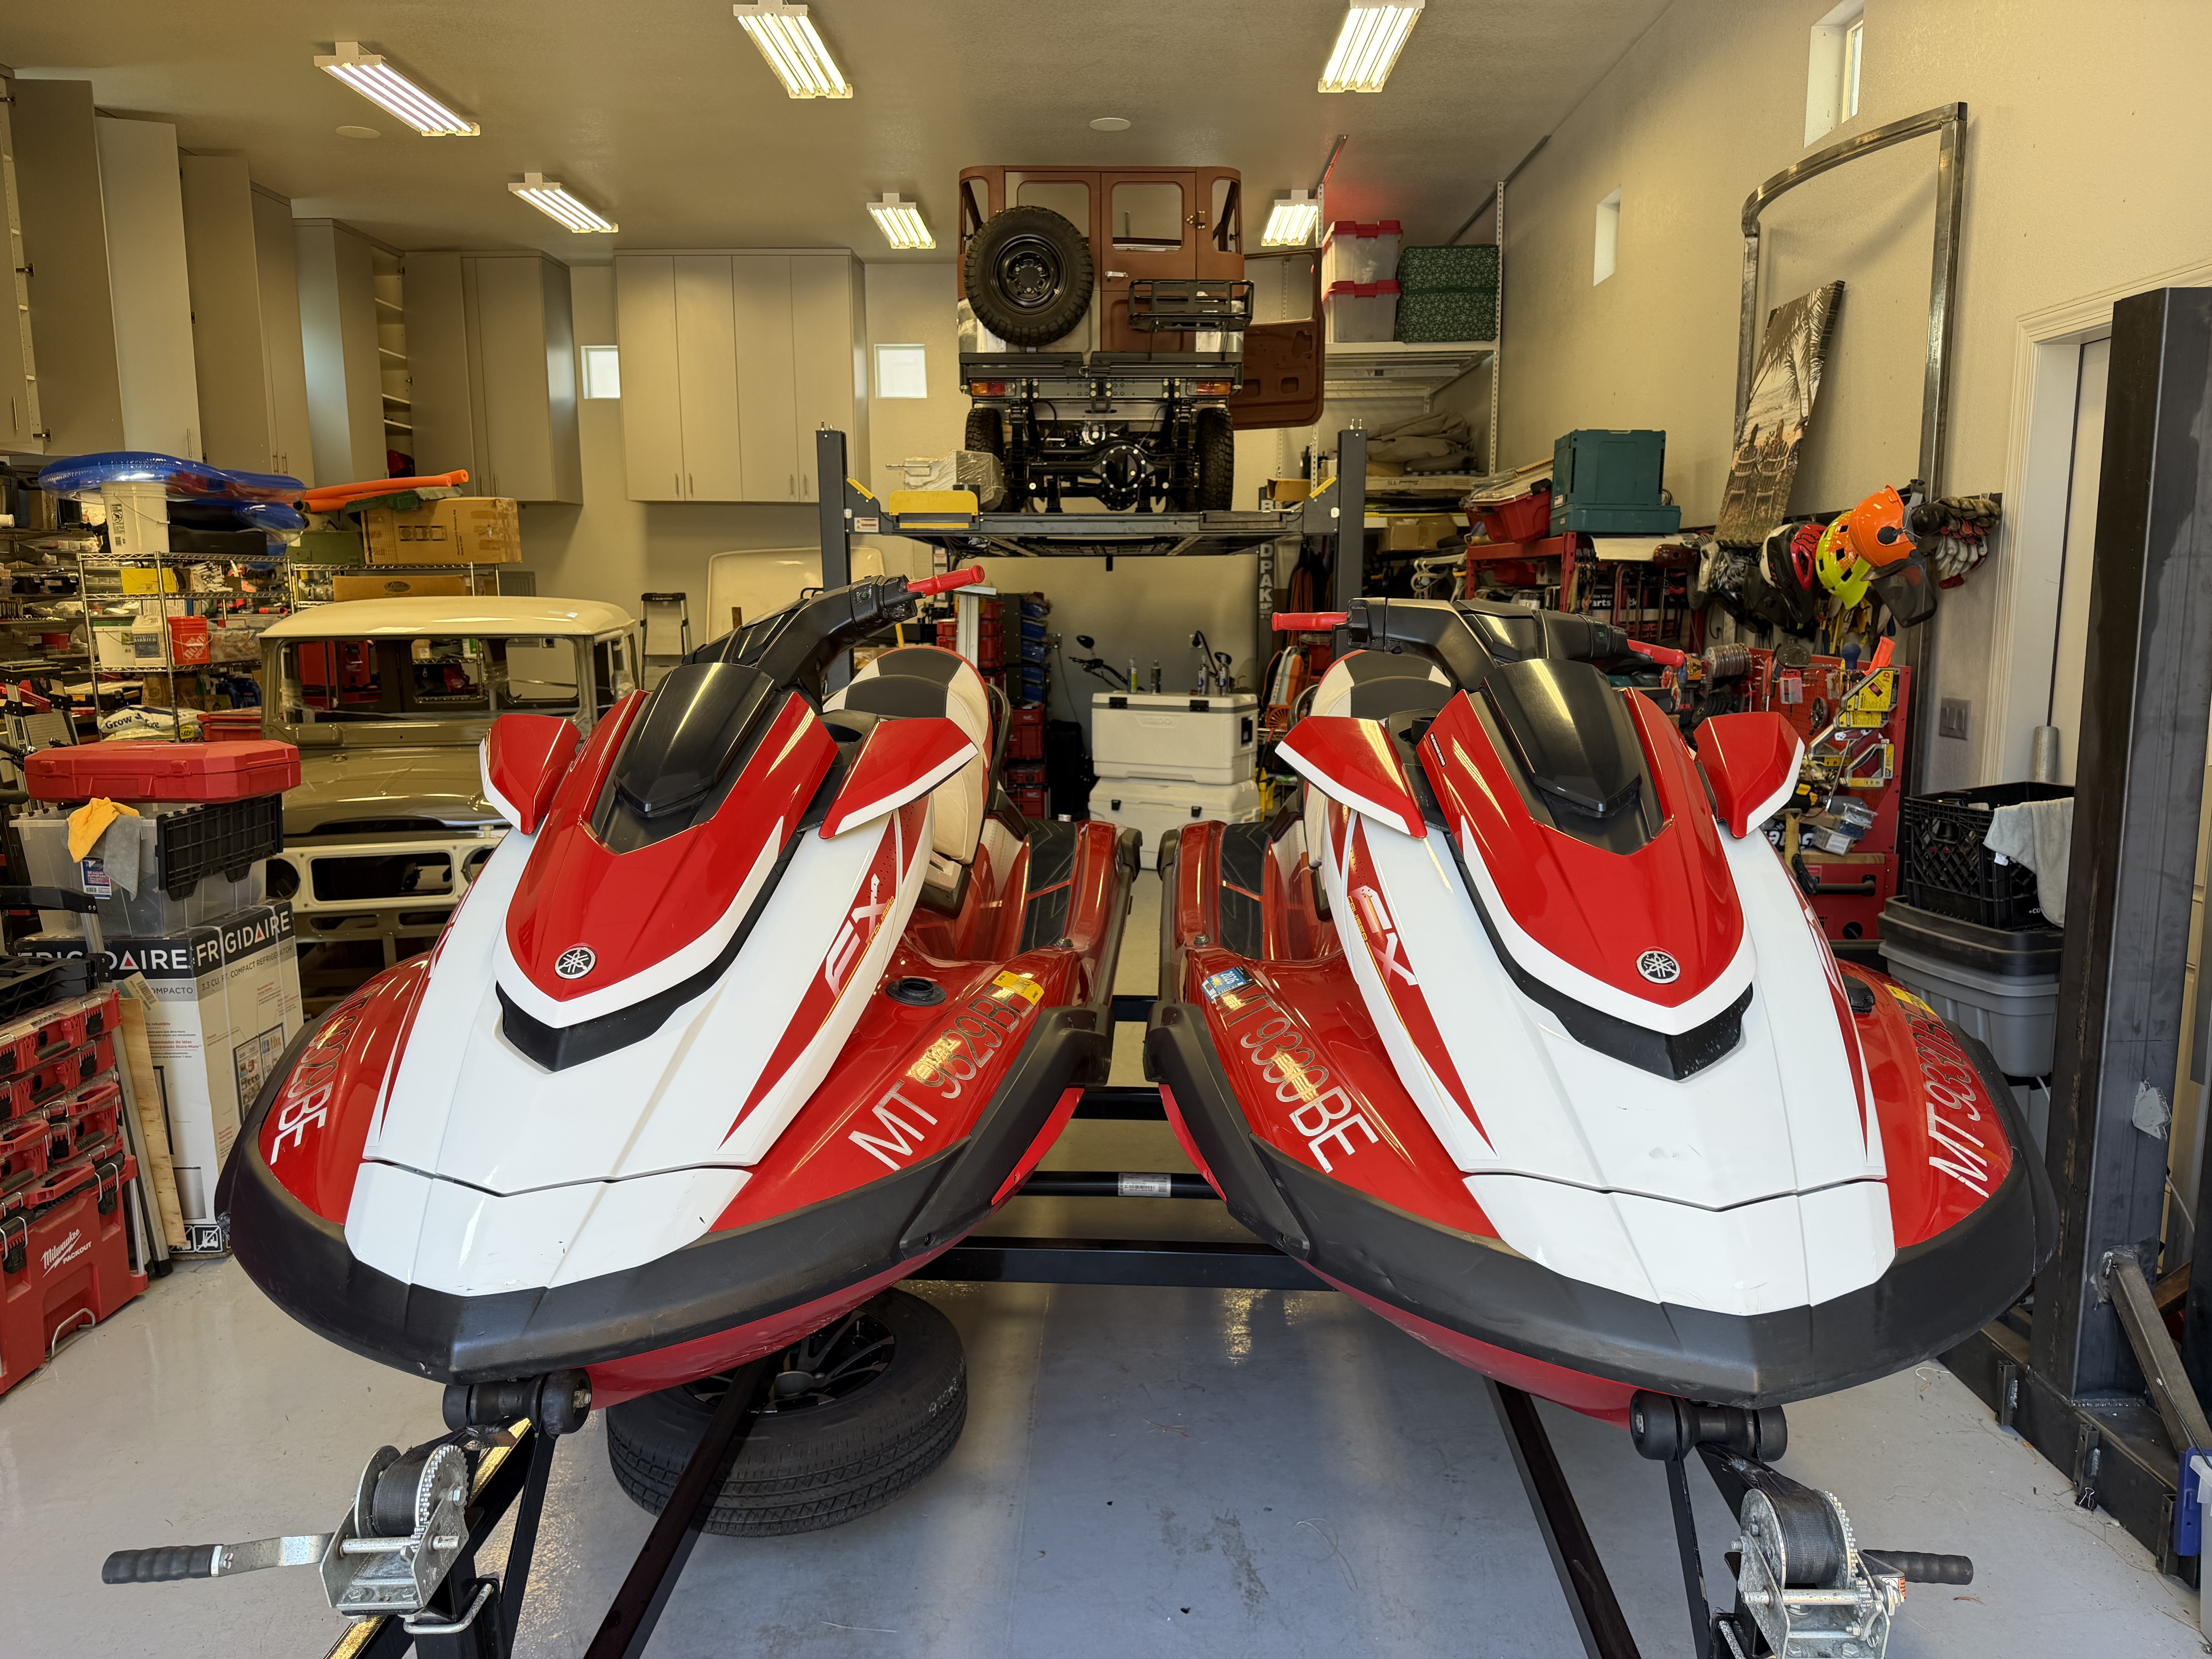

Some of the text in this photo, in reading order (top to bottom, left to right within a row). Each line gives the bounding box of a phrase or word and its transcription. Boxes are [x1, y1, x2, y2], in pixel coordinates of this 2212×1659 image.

[105, 715, 132, 729] Grow
[196, 910, 291, 967] FRGIDAIRE
[1347, 895, 1368, 941] CRUISER
[211, 977, 221, 986] CU.
[230, 961, 255, 978] COMPACT
[256, 945, 292, 966] REFRIGEATOR
[1221, 971, 1240, 984] 2026
[910, 983, 1035, 1099] 9329BE
[1241, 1017, 1379, 1174] 9330BE
[848, 1079, 938, 1171] MT
[1926, 1102, 1989, 1198] MT
[40, 1228, 81, 1269] Milwaukee
[63, 1241, 92, 1264] PACKOUT
